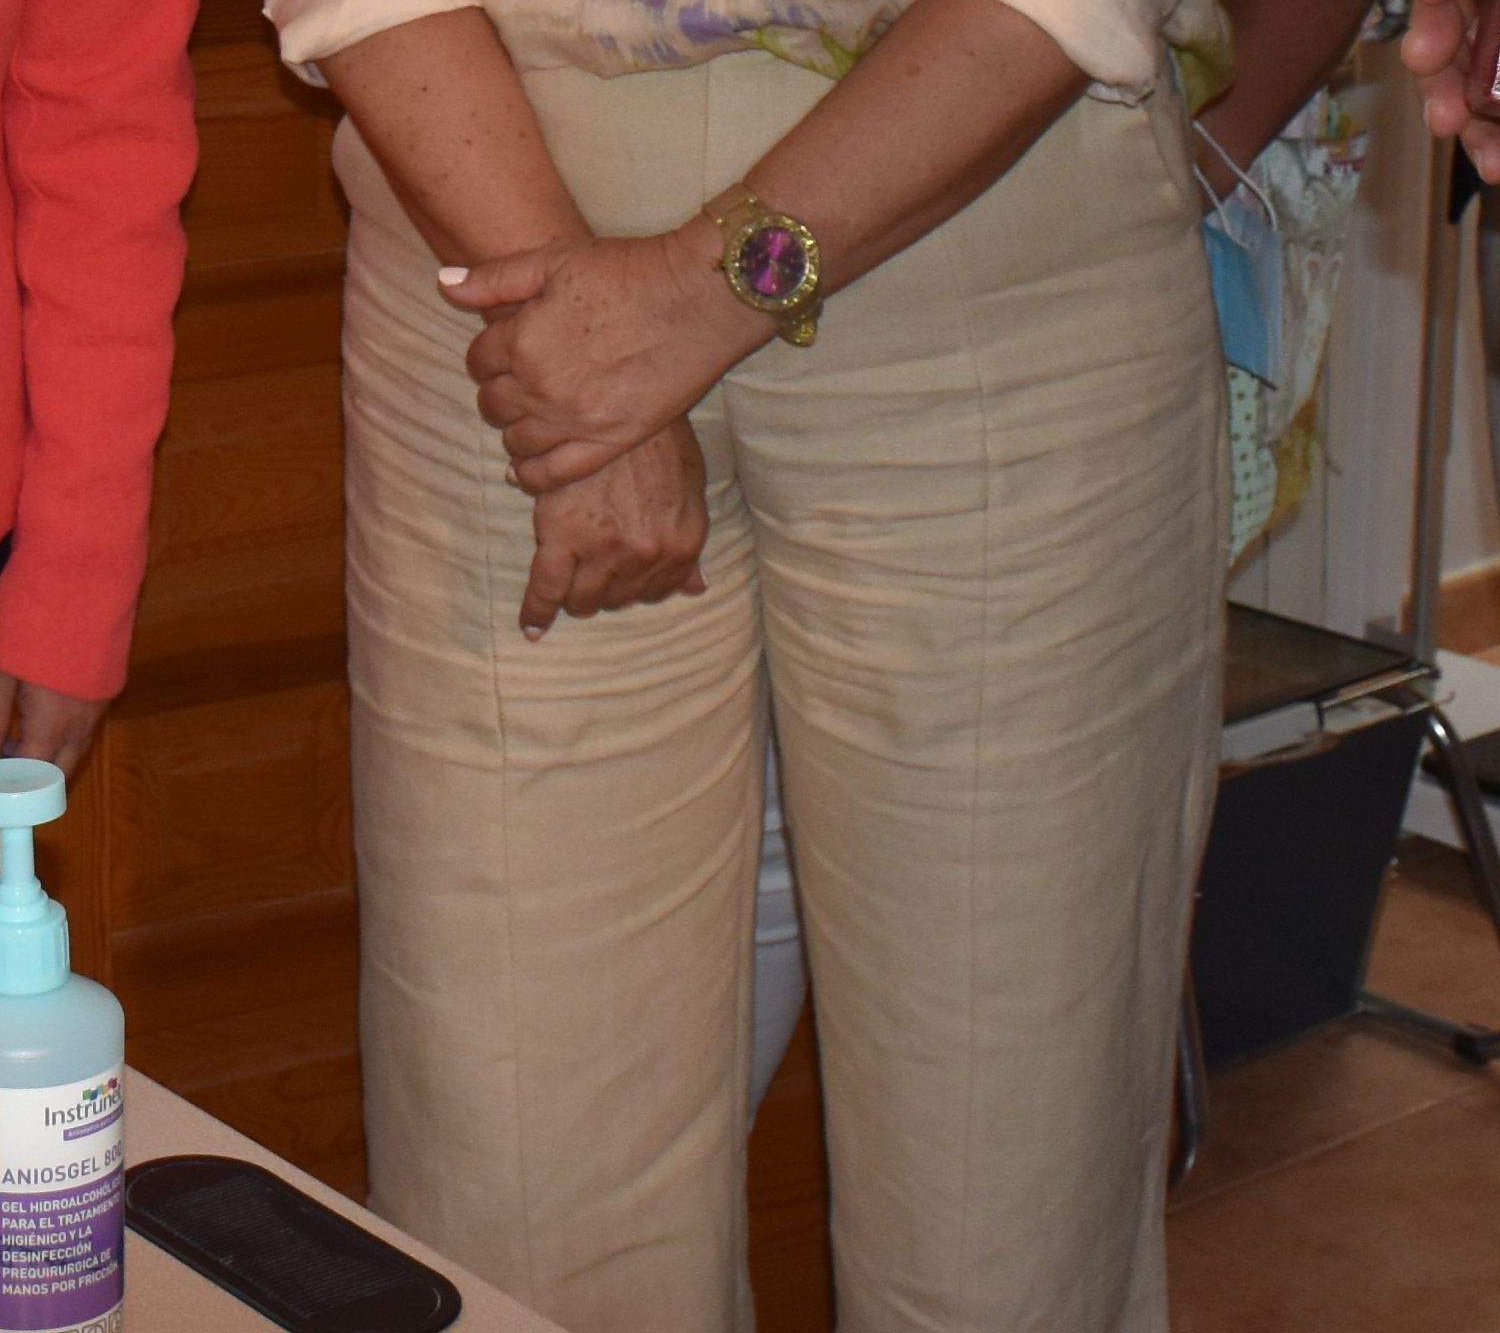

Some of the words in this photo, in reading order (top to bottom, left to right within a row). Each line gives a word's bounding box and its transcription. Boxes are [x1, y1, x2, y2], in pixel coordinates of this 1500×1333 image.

[2, 1155, 100, 1185] ANIOSGEL
[1, 1201, 27, 1213] GEL
[2, 1218, 37, 1230] PARA
[39, 1217, 55, 1229] EL
[2, 1231, 67, 1246] HIGIÉNICO
[69, 1229, 77, 1241] Y
[79, 1225, 93, 1238] LA
[2, 1241, 92, 1263] DESINFECCIÓN
[2, 1283, 49, 1295] MANOS
[51, 1279, 76, 1293] POR
